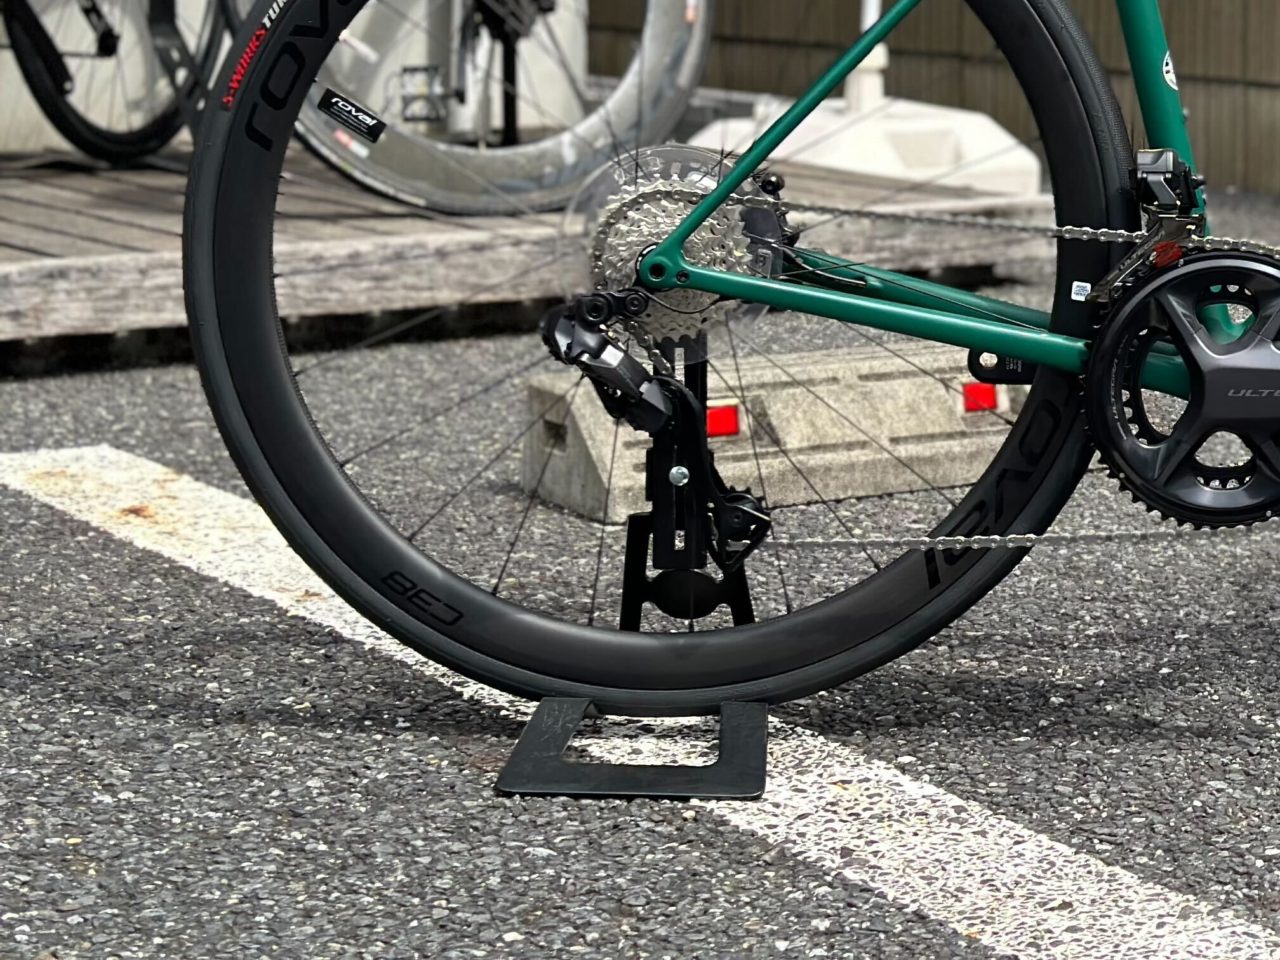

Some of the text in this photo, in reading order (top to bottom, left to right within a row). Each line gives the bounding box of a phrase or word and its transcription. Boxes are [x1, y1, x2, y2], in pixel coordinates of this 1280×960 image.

[222, 25, 267, 109] S-WORKS
[331, 97, 378, 126] roval
[381, 570, 464, 626] C38
